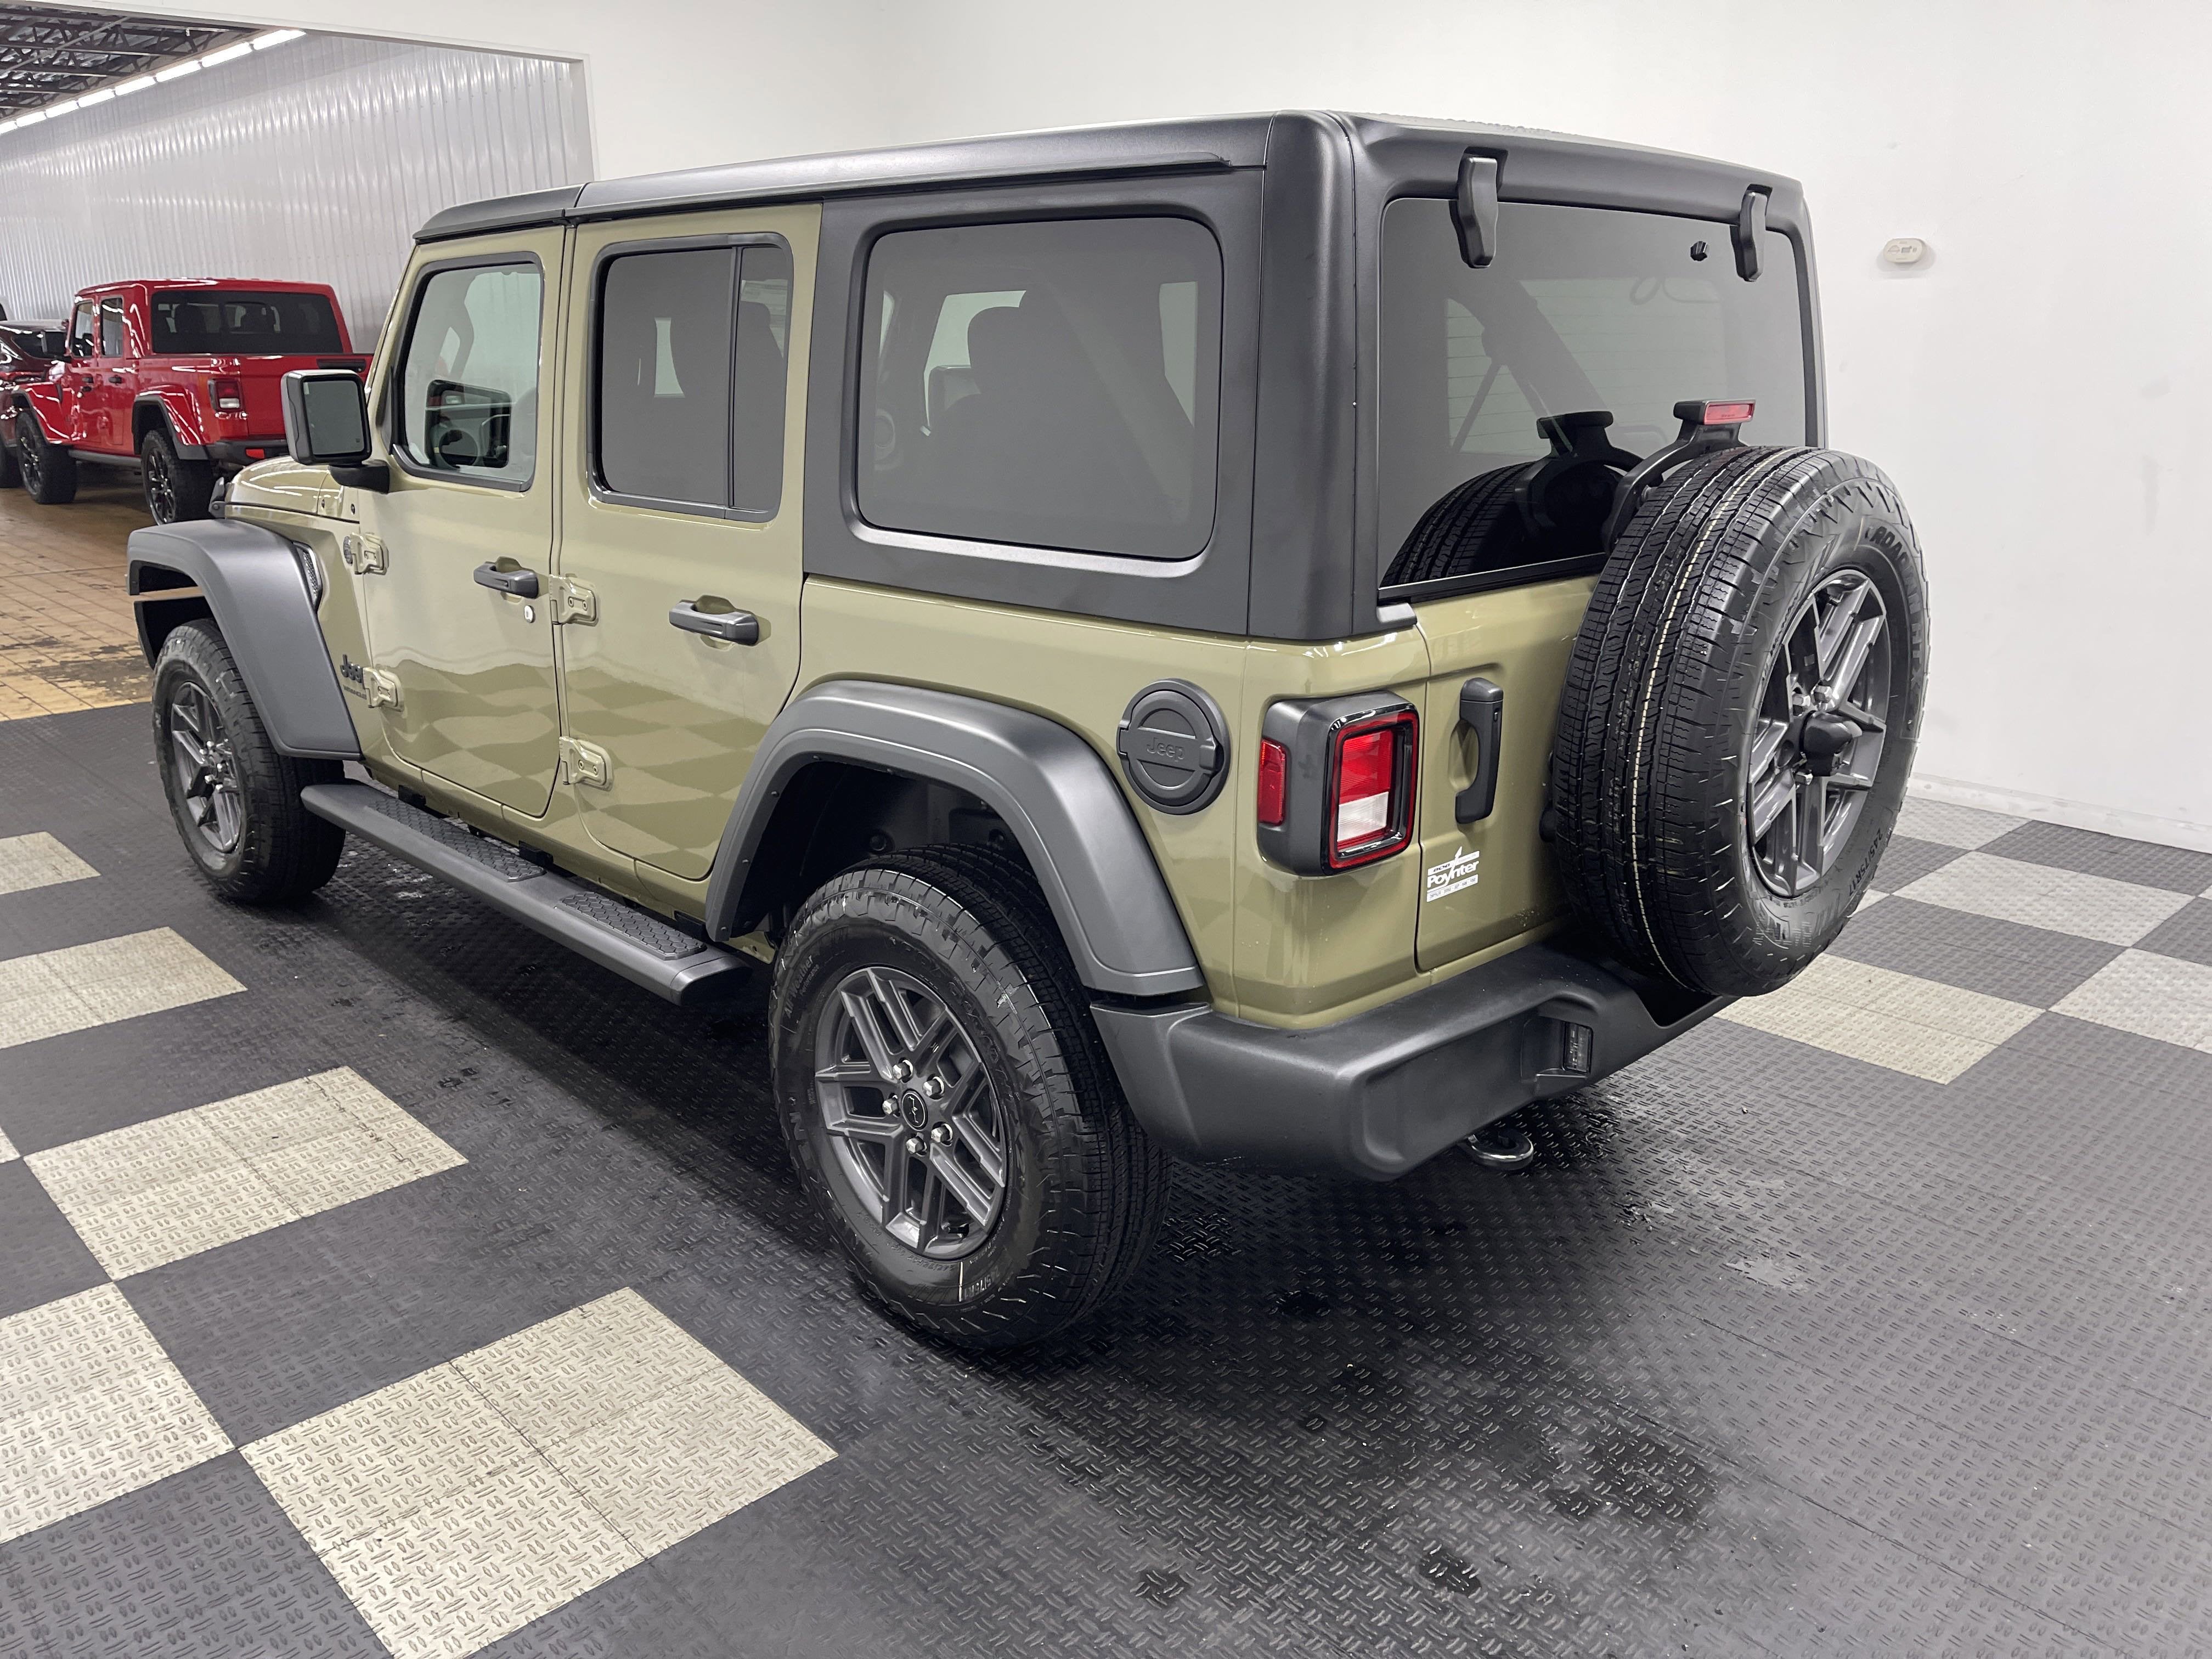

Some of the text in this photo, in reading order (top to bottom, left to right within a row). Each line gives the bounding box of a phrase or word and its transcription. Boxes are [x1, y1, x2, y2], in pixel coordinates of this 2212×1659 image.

[1146, 737, 1186, 763] Jeep
[1427, 860, 1480, 889] Poynter
[1848, 827, 1883, 897] 245/75R17
